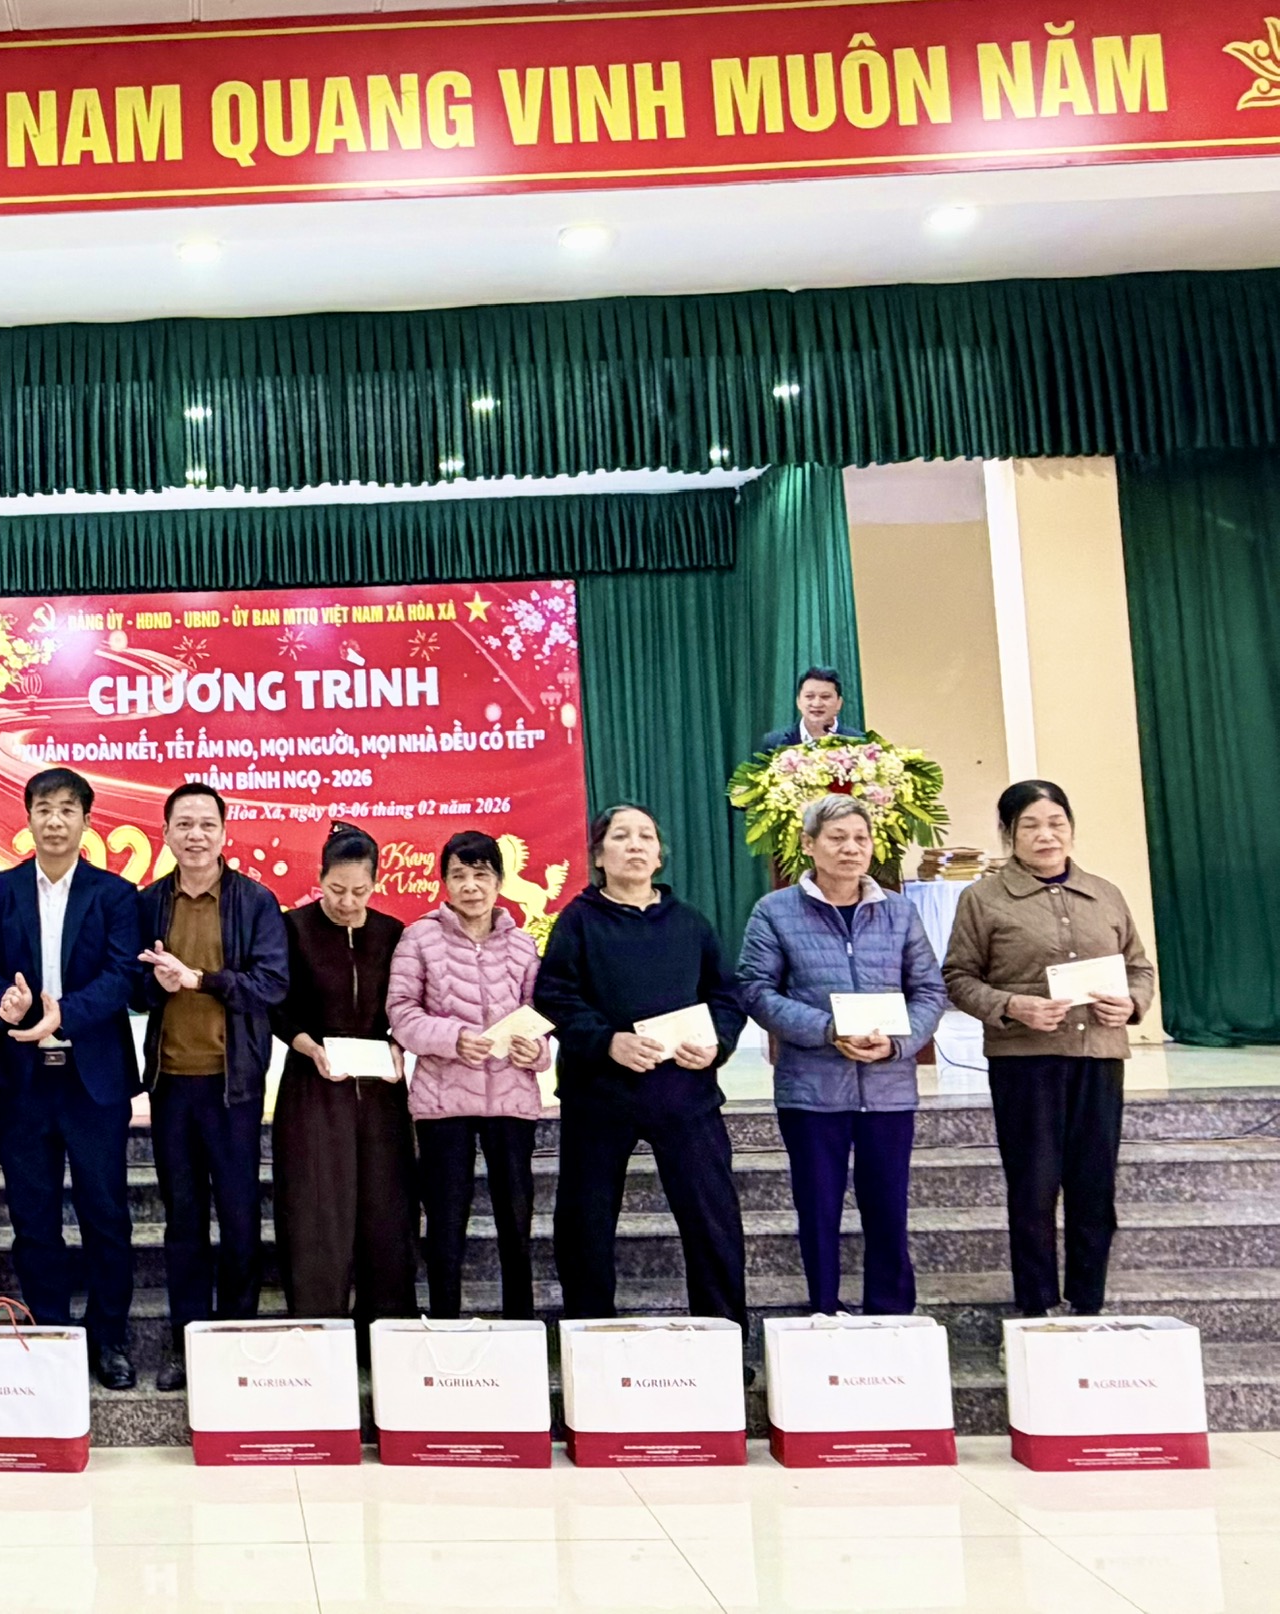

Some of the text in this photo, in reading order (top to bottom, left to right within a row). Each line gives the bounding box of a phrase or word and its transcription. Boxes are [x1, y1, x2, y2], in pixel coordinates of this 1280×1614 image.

[6, 83, 183, 169] NAM
[210, 70, 476, 168] QUANG
[497, 60, 686, 146] VINH
[710, 32, 952, 136] MUÔN
[975, 19, 1168, 121] NĂM
[184, 609, 220, 629] UBND
[252, 607, 280, 626] BAN
[282, 607, 319, 627] MTTQ
[321, 603, 350, 628] VIỆT
[352, 605, 384, 624] NAM
[88, 647, 440, 715] CHƯƠNG TRÌNH
[71, 733, 123, 762] ĐOÀN
[126, 728, 164, 763] KẾT,
[165, 727, 195, 760] TẾT
[197, 726, 227, 759] ẤM
[227, 738, 259, 761] NO,
[260, 735, 293, 763] MỌI
[295, 727, 360, 758] NGƯỜI,
[362, 733, 396, 760] MỌI
[399, 724, 438, 753] NHÀ
[439, 719, 477, 752] ĐỀU
[480, 722, 504, 751] CÓ
[235, 763, 281, 790] BÍNH
[283, 769, 321, 795] NGỌ
[331, 769, 373, 788] 2026
[328, 802, 370, 818] 05-06
[418, 799, 437, 815] 02
[439, 798, 471, 815] năm
[475, 797, 512, 814] 2026
[380, 841, 436, 876] Khang
[249, 1376, 314, 1388] AGRIBANK
[434, 1376, 501, 1389] AGRIBANK
[633, 1377, 698, 1389] AGRIBANK
[841, 1374, 907, 1387] AGRIBANK
[1091, 1378, 1159, 1390] AGRIBANK
